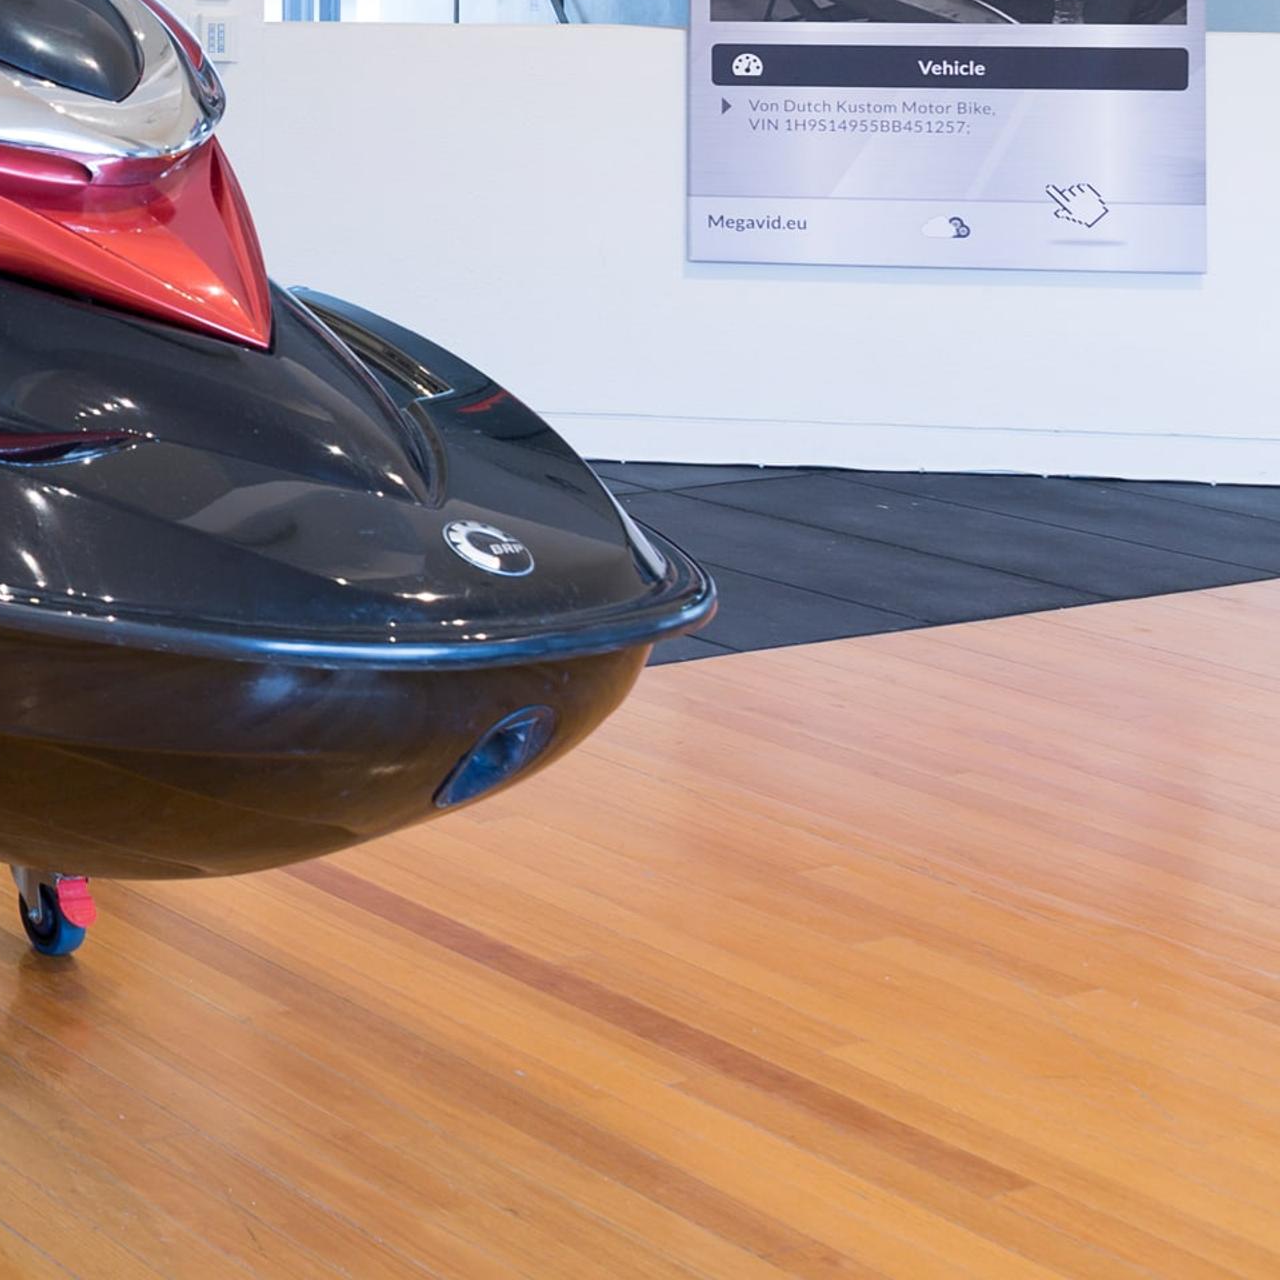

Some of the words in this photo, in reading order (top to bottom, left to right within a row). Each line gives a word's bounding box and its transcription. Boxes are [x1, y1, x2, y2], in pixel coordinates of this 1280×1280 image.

[917, 59, 986, 77] Vehicle
[748, 99, 779, 112] Von
[783, 100, 832, 113] Dutch
[836, 100, 898, 114] Kustom
[902, 101, 952, 115] Motor
[748, 118, 779, 131] VIN
[707, 213, 808, 235] Megavid.eu
